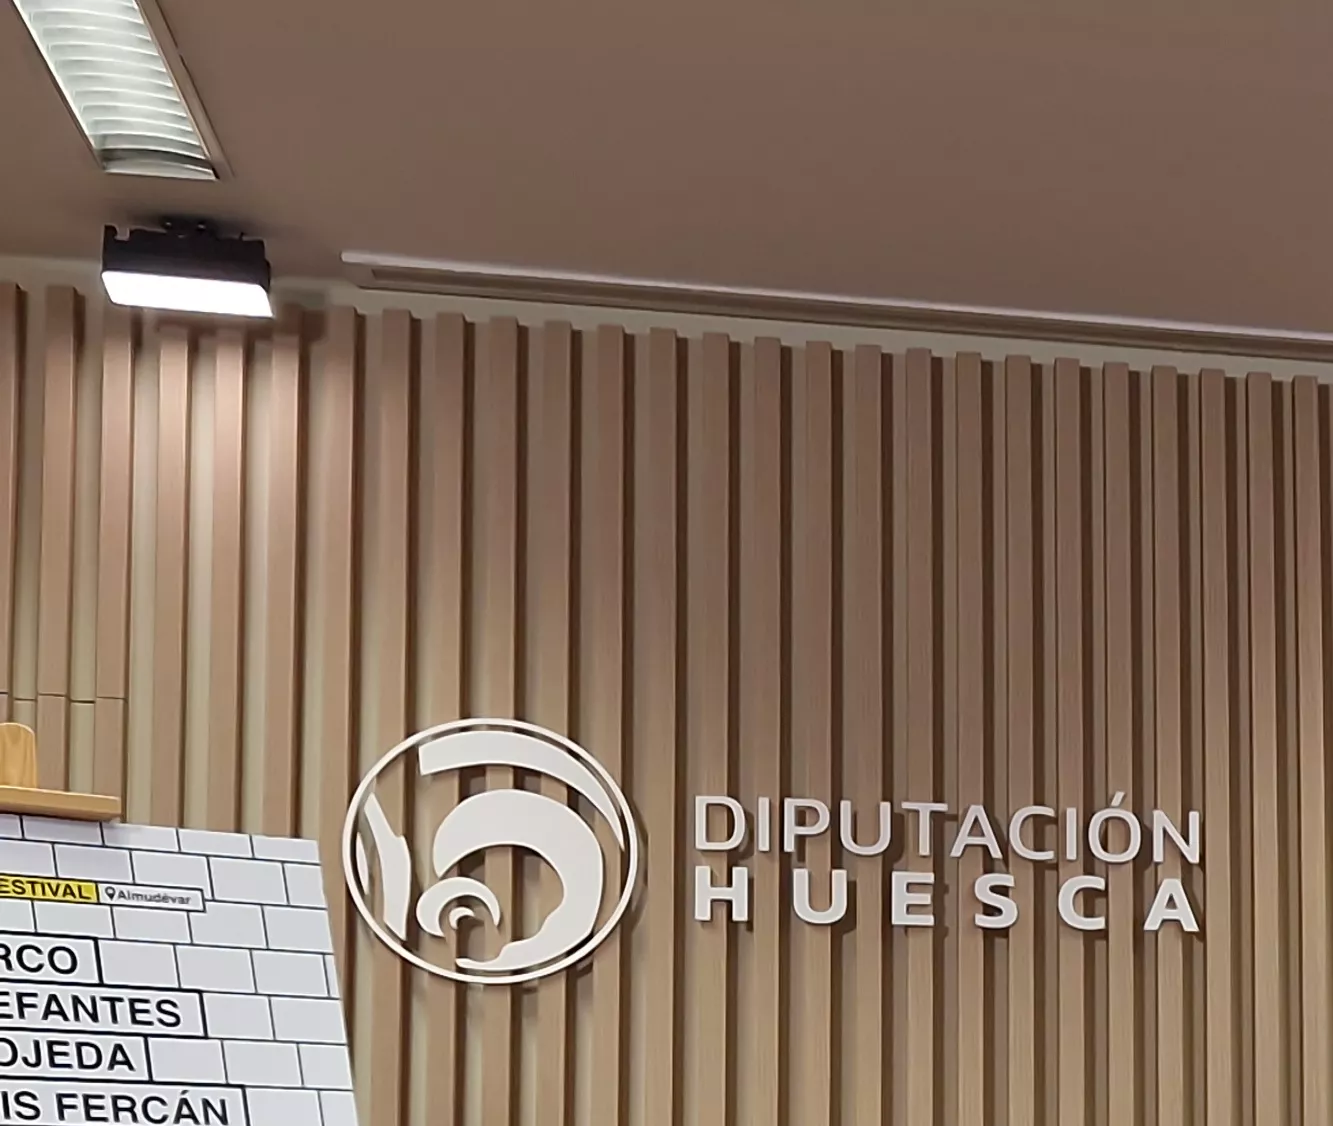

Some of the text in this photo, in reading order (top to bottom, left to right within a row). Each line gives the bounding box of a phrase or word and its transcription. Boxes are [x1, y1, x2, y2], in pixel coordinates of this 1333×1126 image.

[694, 791, 1201, 865] DIPUTACIÓN
[117, 890, 192, 905] Almudévar
[694, 865, 1200, 933] HUESCA
[0, 1037, 136, 1072] OJEDA
[55, 1089, 229, 1126] FERCÁN
